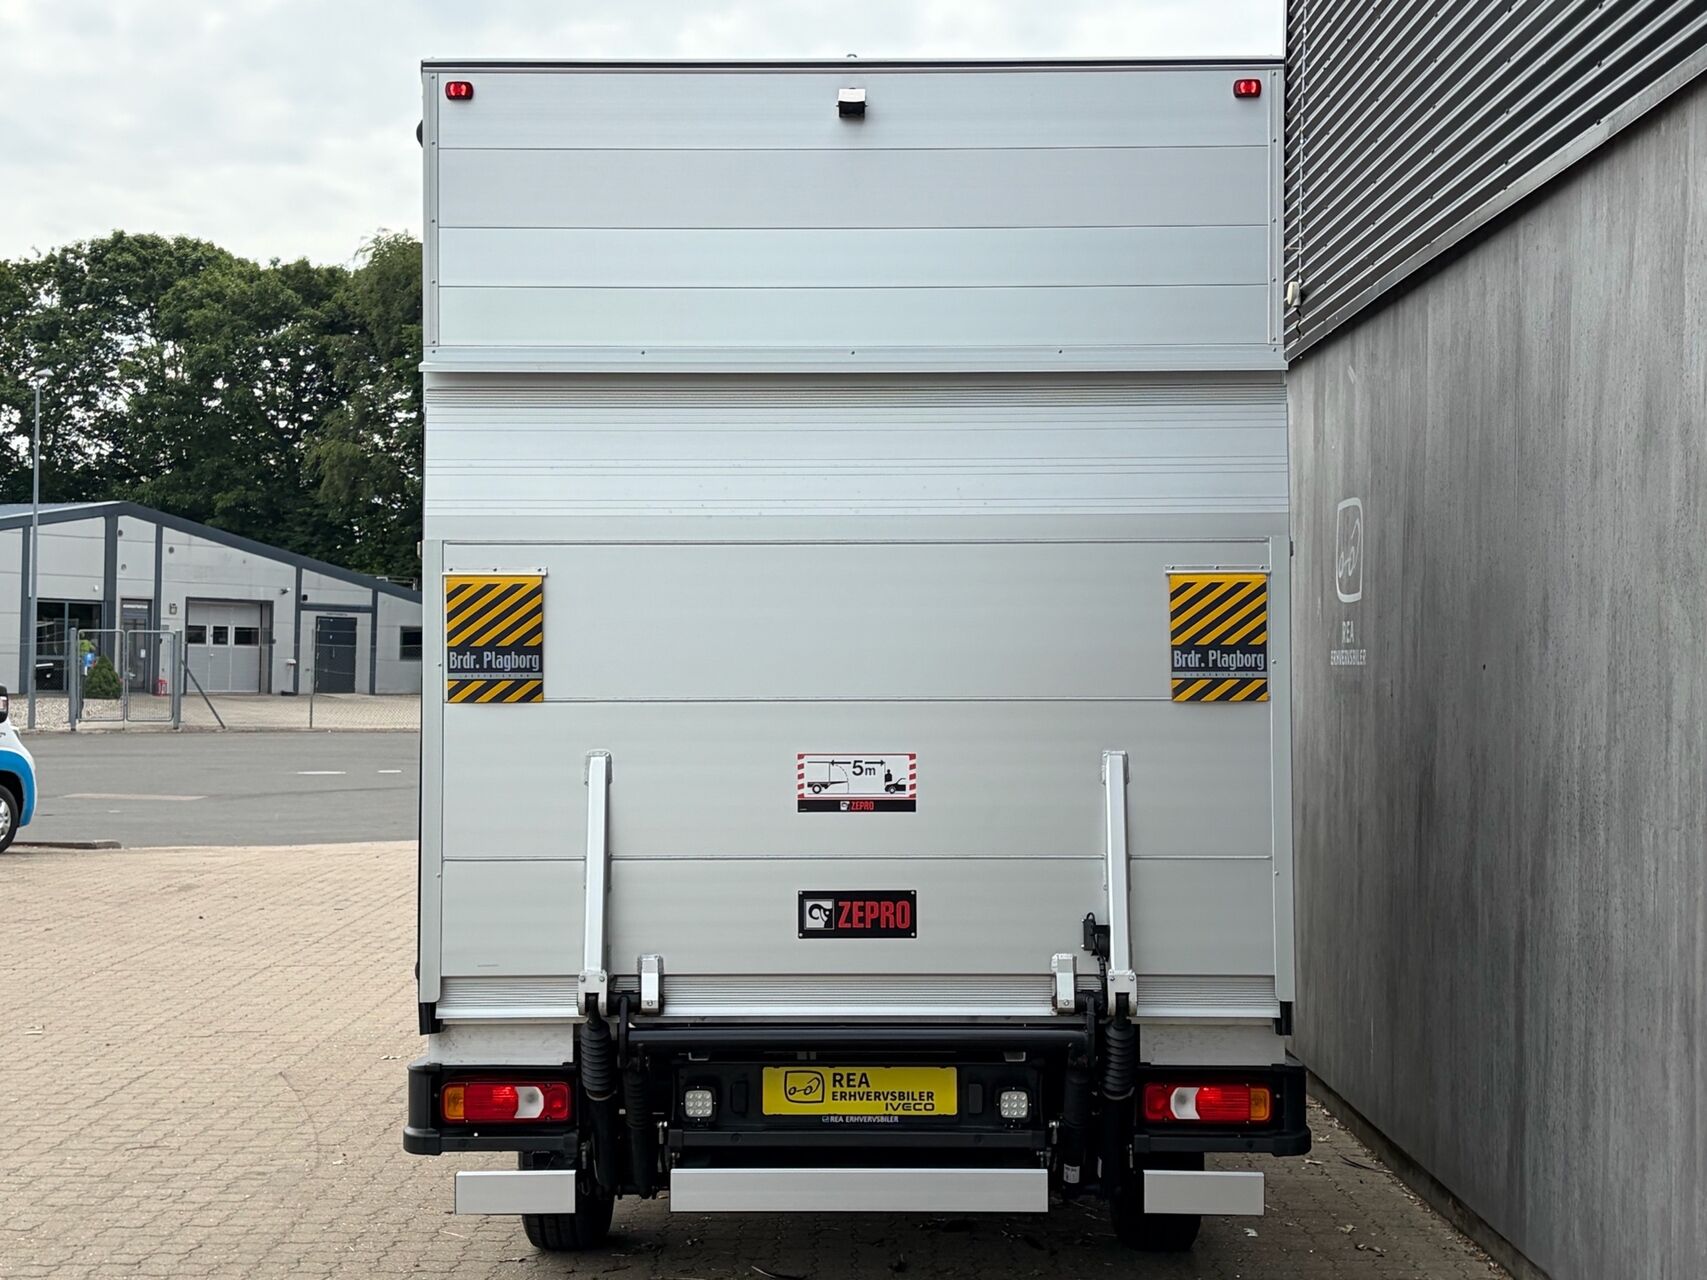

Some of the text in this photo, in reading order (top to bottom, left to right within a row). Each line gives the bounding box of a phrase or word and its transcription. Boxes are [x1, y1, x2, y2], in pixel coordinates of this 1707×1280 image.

[449, 651, 540, 672] Brdr. Plagborg
[1173, 650, 1265, 671] Brdr. Plagborg
[850, 801, 875, 811] ZEPRO
[838, 900, 911, 929] ZEPRO
[832, 1072, 871, 1088] REA
[831, 1091, 935, 1102] ERHVERVSBILER
[885, 1102, 935, 1112] IVECO
